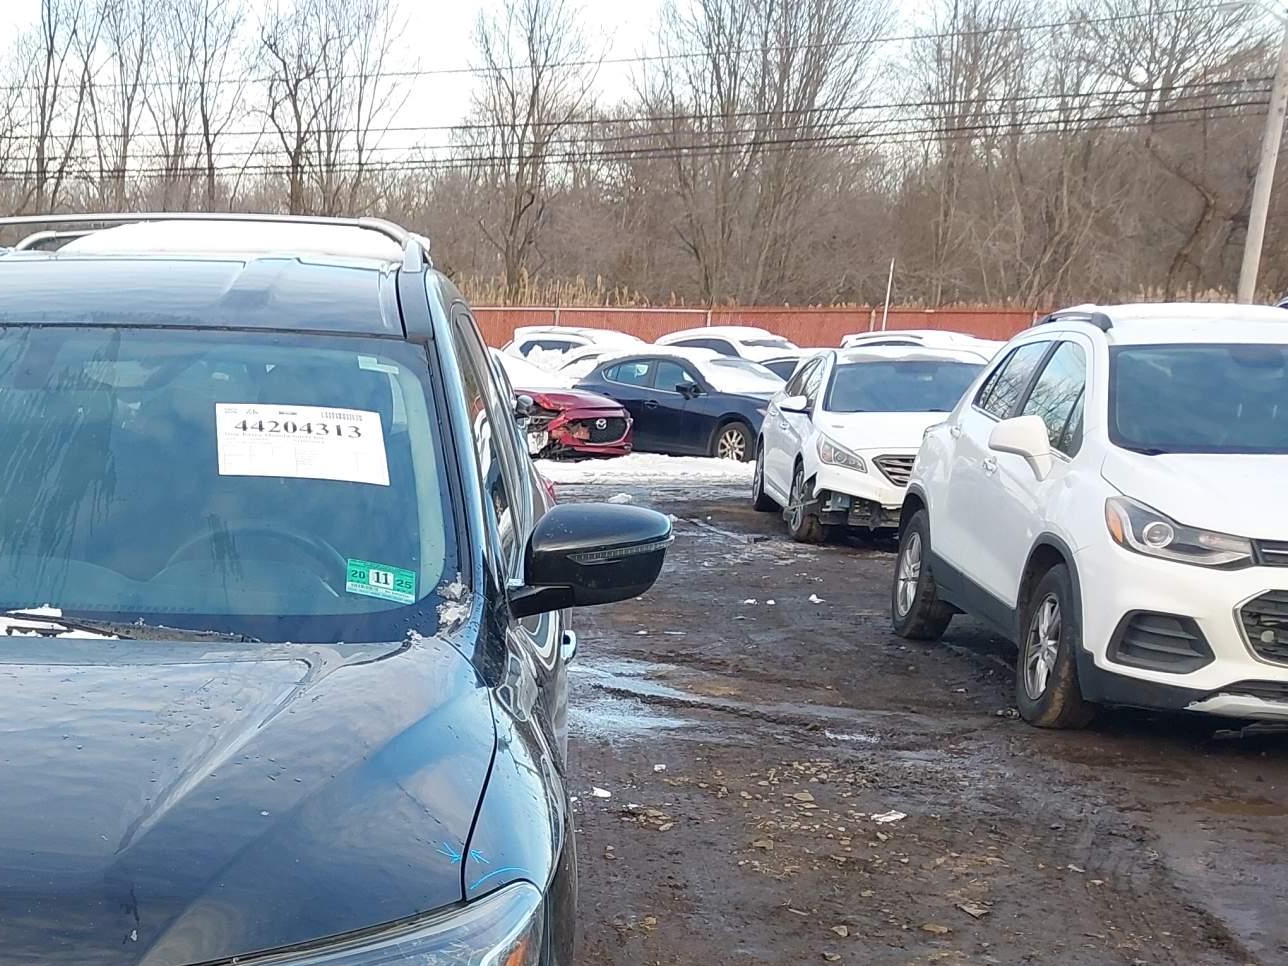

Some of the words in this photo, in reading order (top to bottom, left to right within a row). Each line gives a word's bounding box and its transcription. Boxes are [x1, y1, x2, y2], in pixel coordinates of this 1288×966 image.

[234, 419, 363, 439] 44204313
[351, 569, 366, 579] 20
[374, 571, 391, 585] 11
[396, 579, 412, 589] 25
